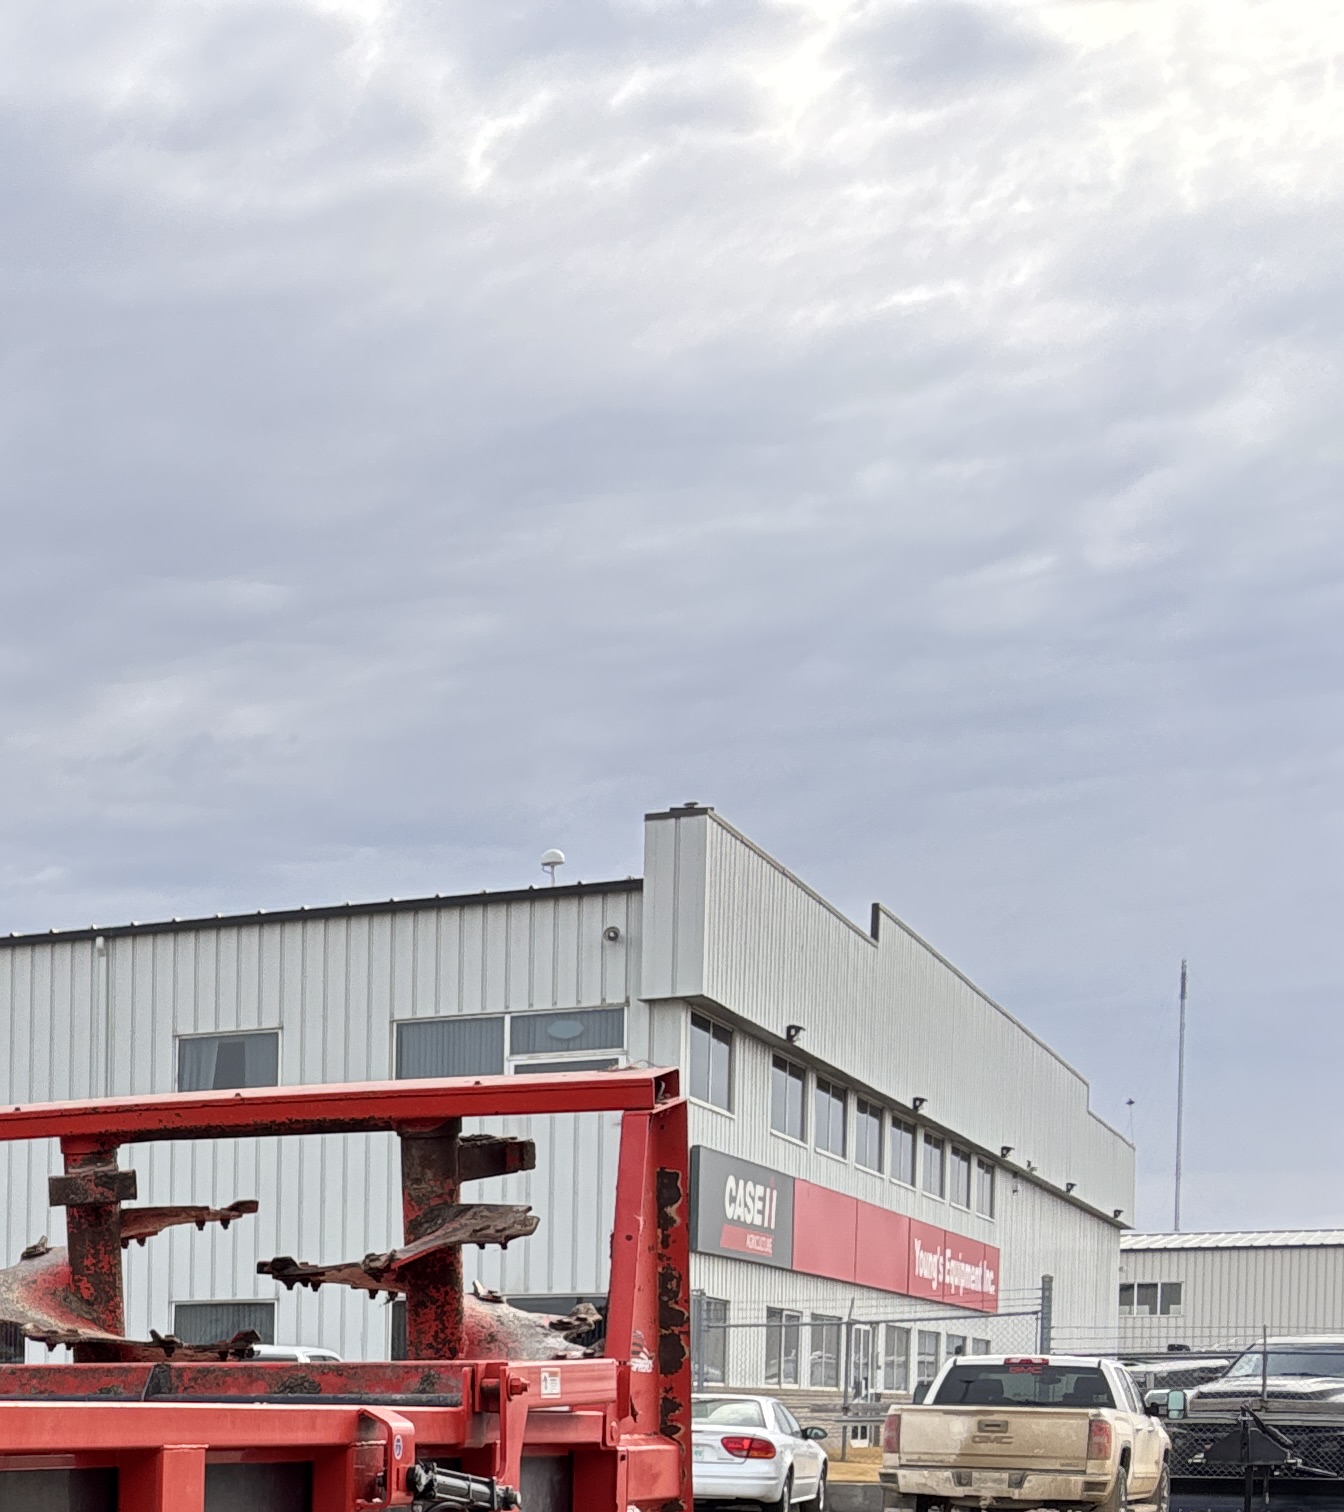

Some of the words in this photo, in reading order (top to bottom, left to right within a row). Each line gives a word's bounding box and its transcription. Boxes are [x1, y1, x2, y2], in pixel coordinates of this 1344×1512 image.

[724, 1174, 765, 1226] CASE
[914, 1237, 944, 1291] Young's
[944, 1248, 983, 1297] Equipment
[1008, 1365, 1043, 1374] GMC
[971, 1435, 1014, 1444] GMC
